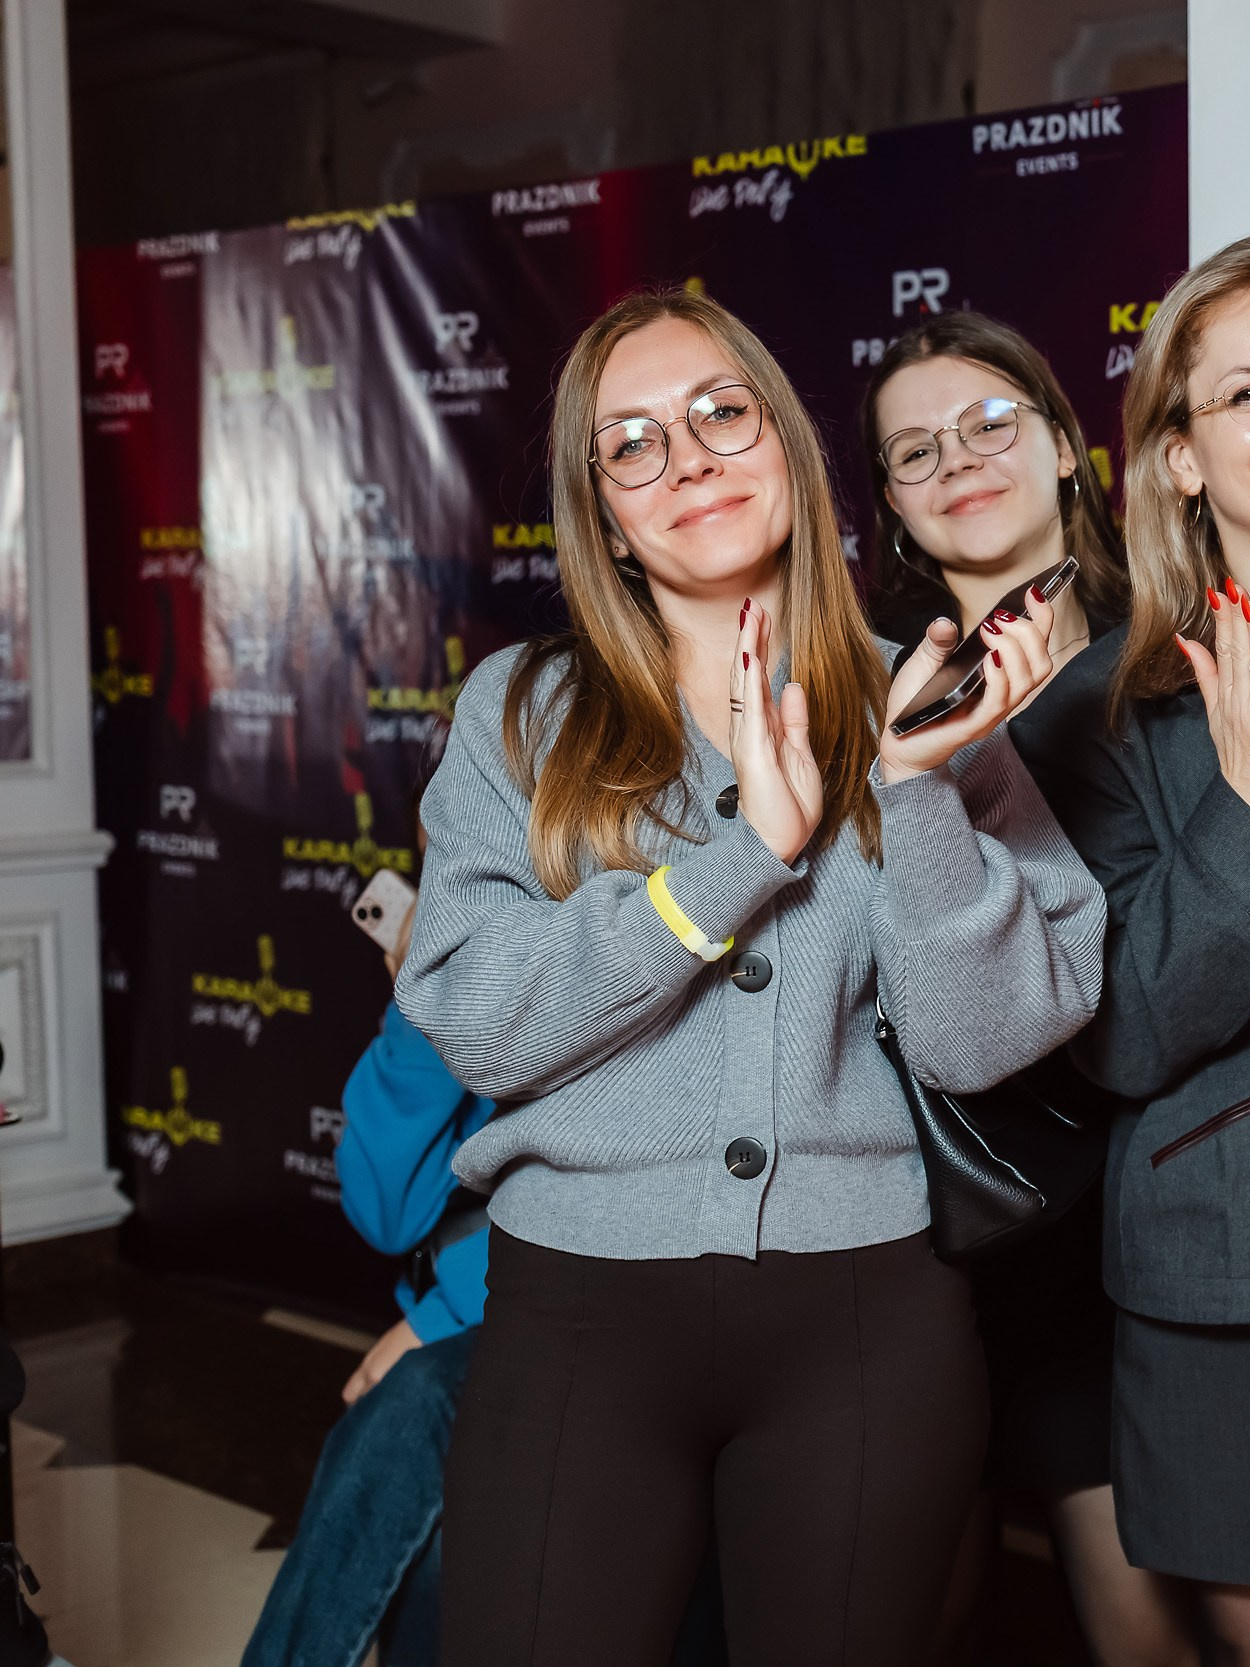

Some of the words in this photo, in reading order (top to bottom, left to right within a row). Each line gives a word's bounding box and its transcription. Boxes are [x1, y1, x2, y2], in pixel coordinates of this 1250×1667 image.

[972, 105, 1123, 154] PRAZDNIK
[1016, 151, 1079, 178] EVENTS
[892, 266, 951, 318] PR
[159, 783, 196, 823] PR
